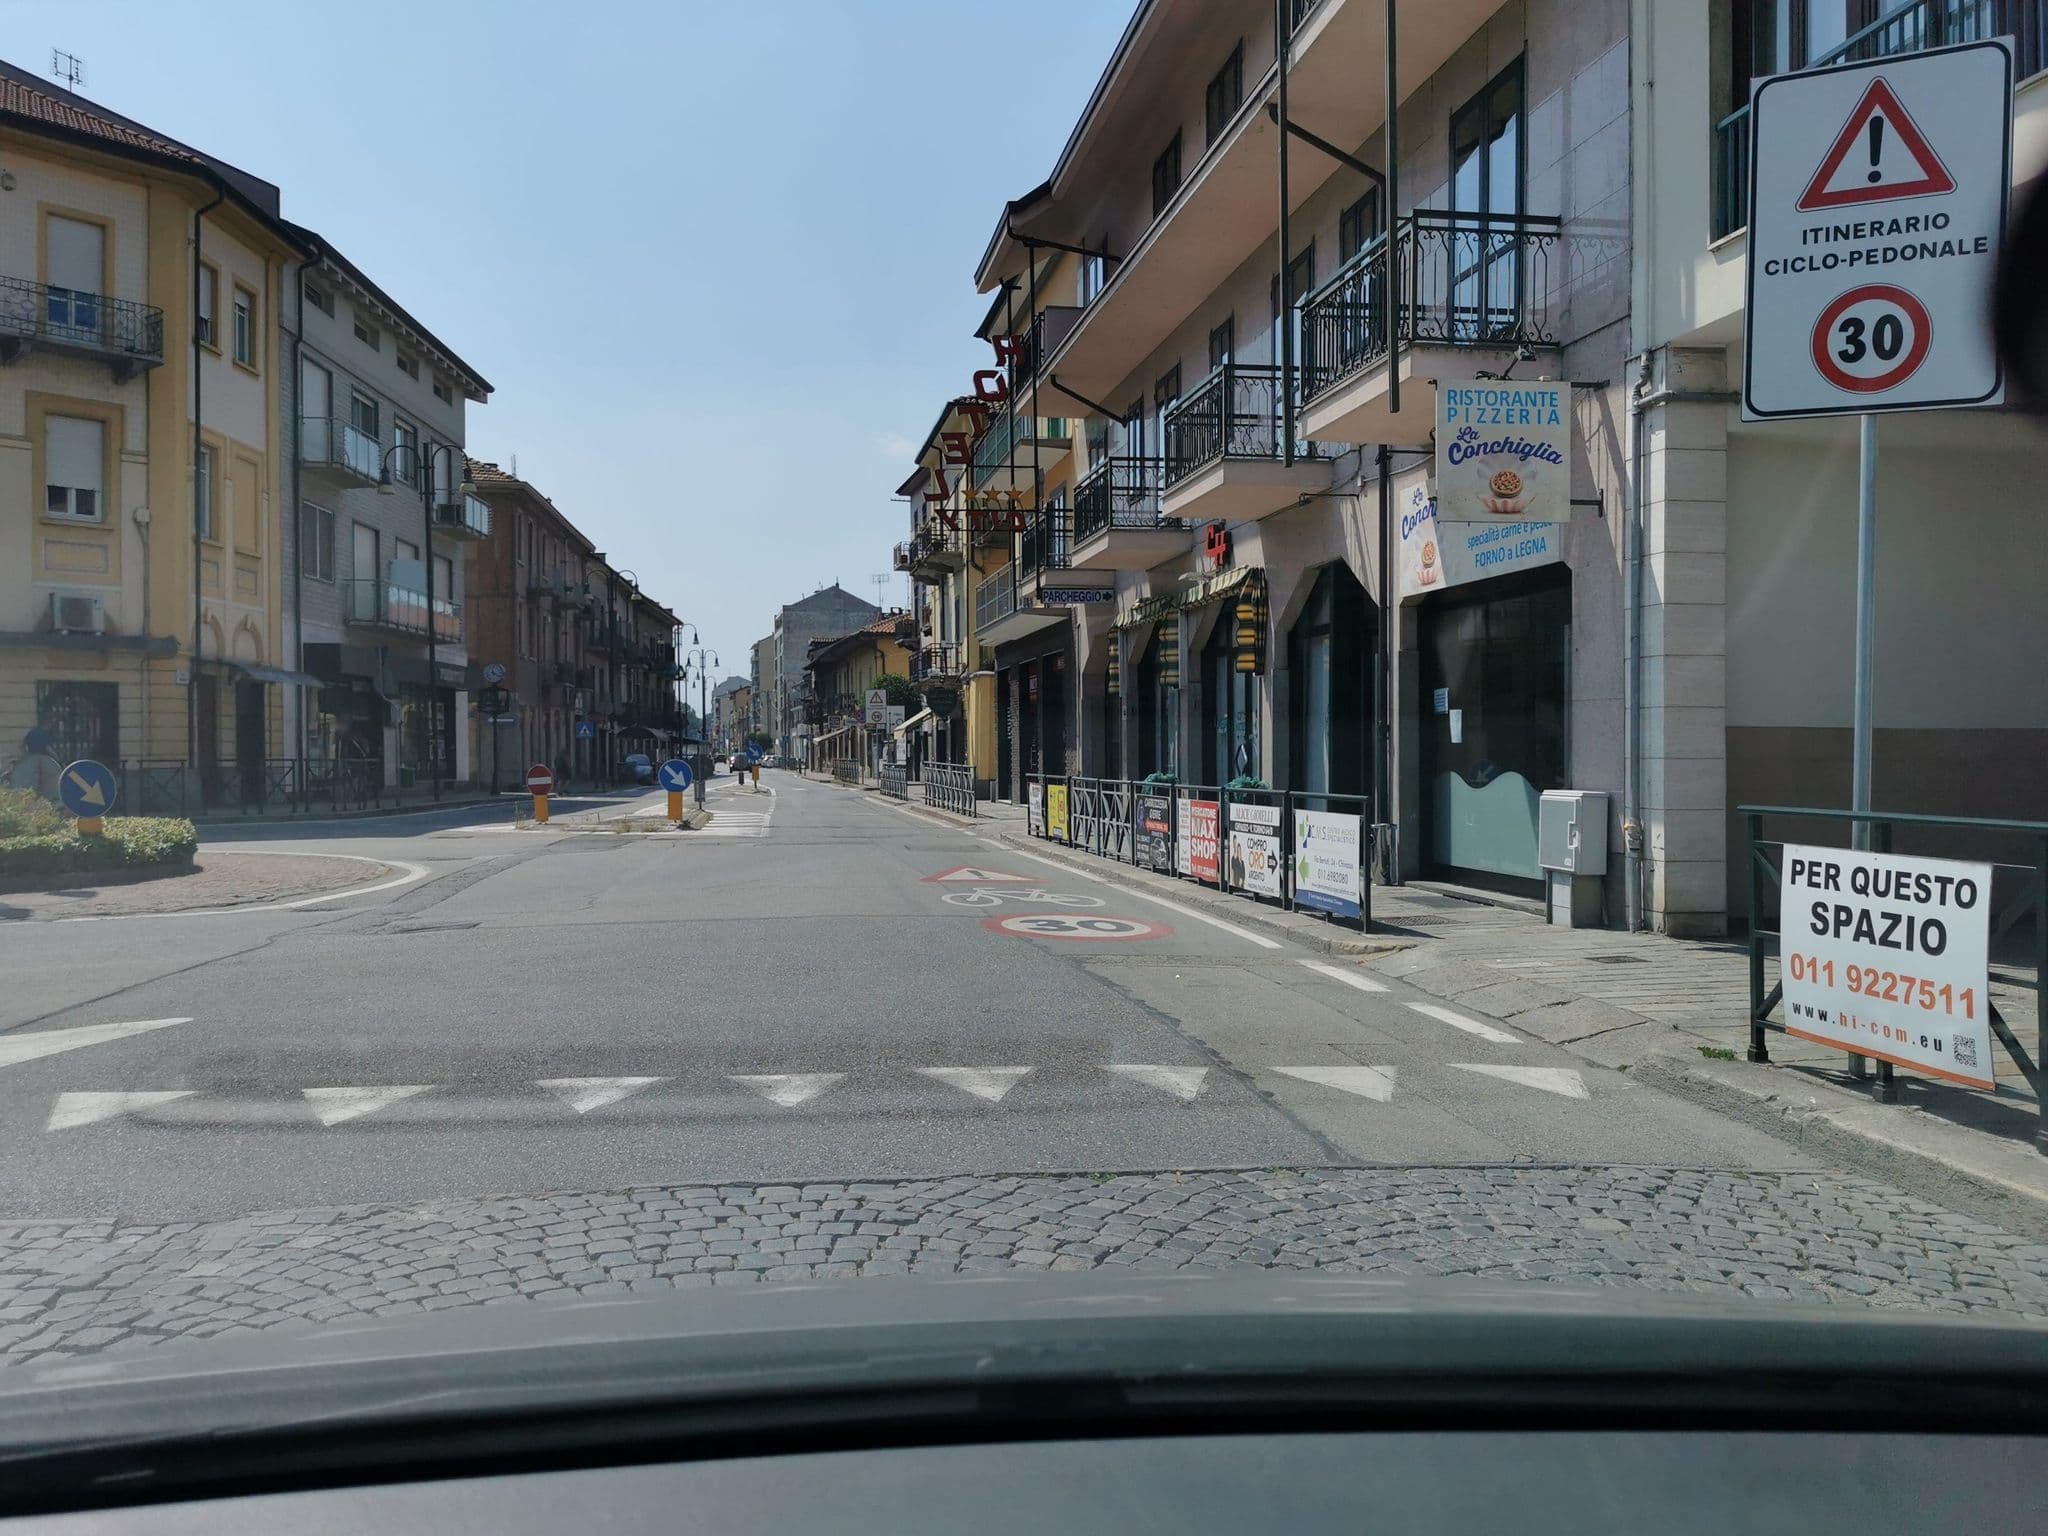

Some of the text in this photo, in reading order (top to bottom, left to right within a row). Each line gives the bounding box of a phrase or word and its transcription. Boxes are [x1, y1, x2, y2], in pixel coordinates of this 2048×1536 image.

[1802, 212, 1950, 245] ITINERARIO
[1765, 236, 1989, 276] CICLO-PEDONALE
[1838, 314, 1904, 363] 30
[1447, 389, 1559, 408] RISTORANTE
[1447, 407, 1561, 425] PIZZERIA
[1456, 426, 1480, 443] La
[1448, 435, 1563, 465] Conchiglia
[1467, 529, 1500, 549] specialità
[1501, 524, 1521, 538] carne
[1475, 537, 1547, 568] FORNO a LEGNA
[1043, 591, 1101, 602] PARCHEGGIO
[1191, 817, 1216, 839] MAX
[1191, 837, 1217, 860] SHOP
[1247, 837, 1267, 852] COMPRO
[1248, 851, 1265, 870] ORO
[1791, 859, 1978, 909] PER QUESTO
[1020, 918, 1136, 933] 30
[1810, 901, 1947, 957] SPAZIO
[1790, 953, 1975, 1019] 011 9227511
[1792, 1002, 1943, 1052] www.hi-com.eu
